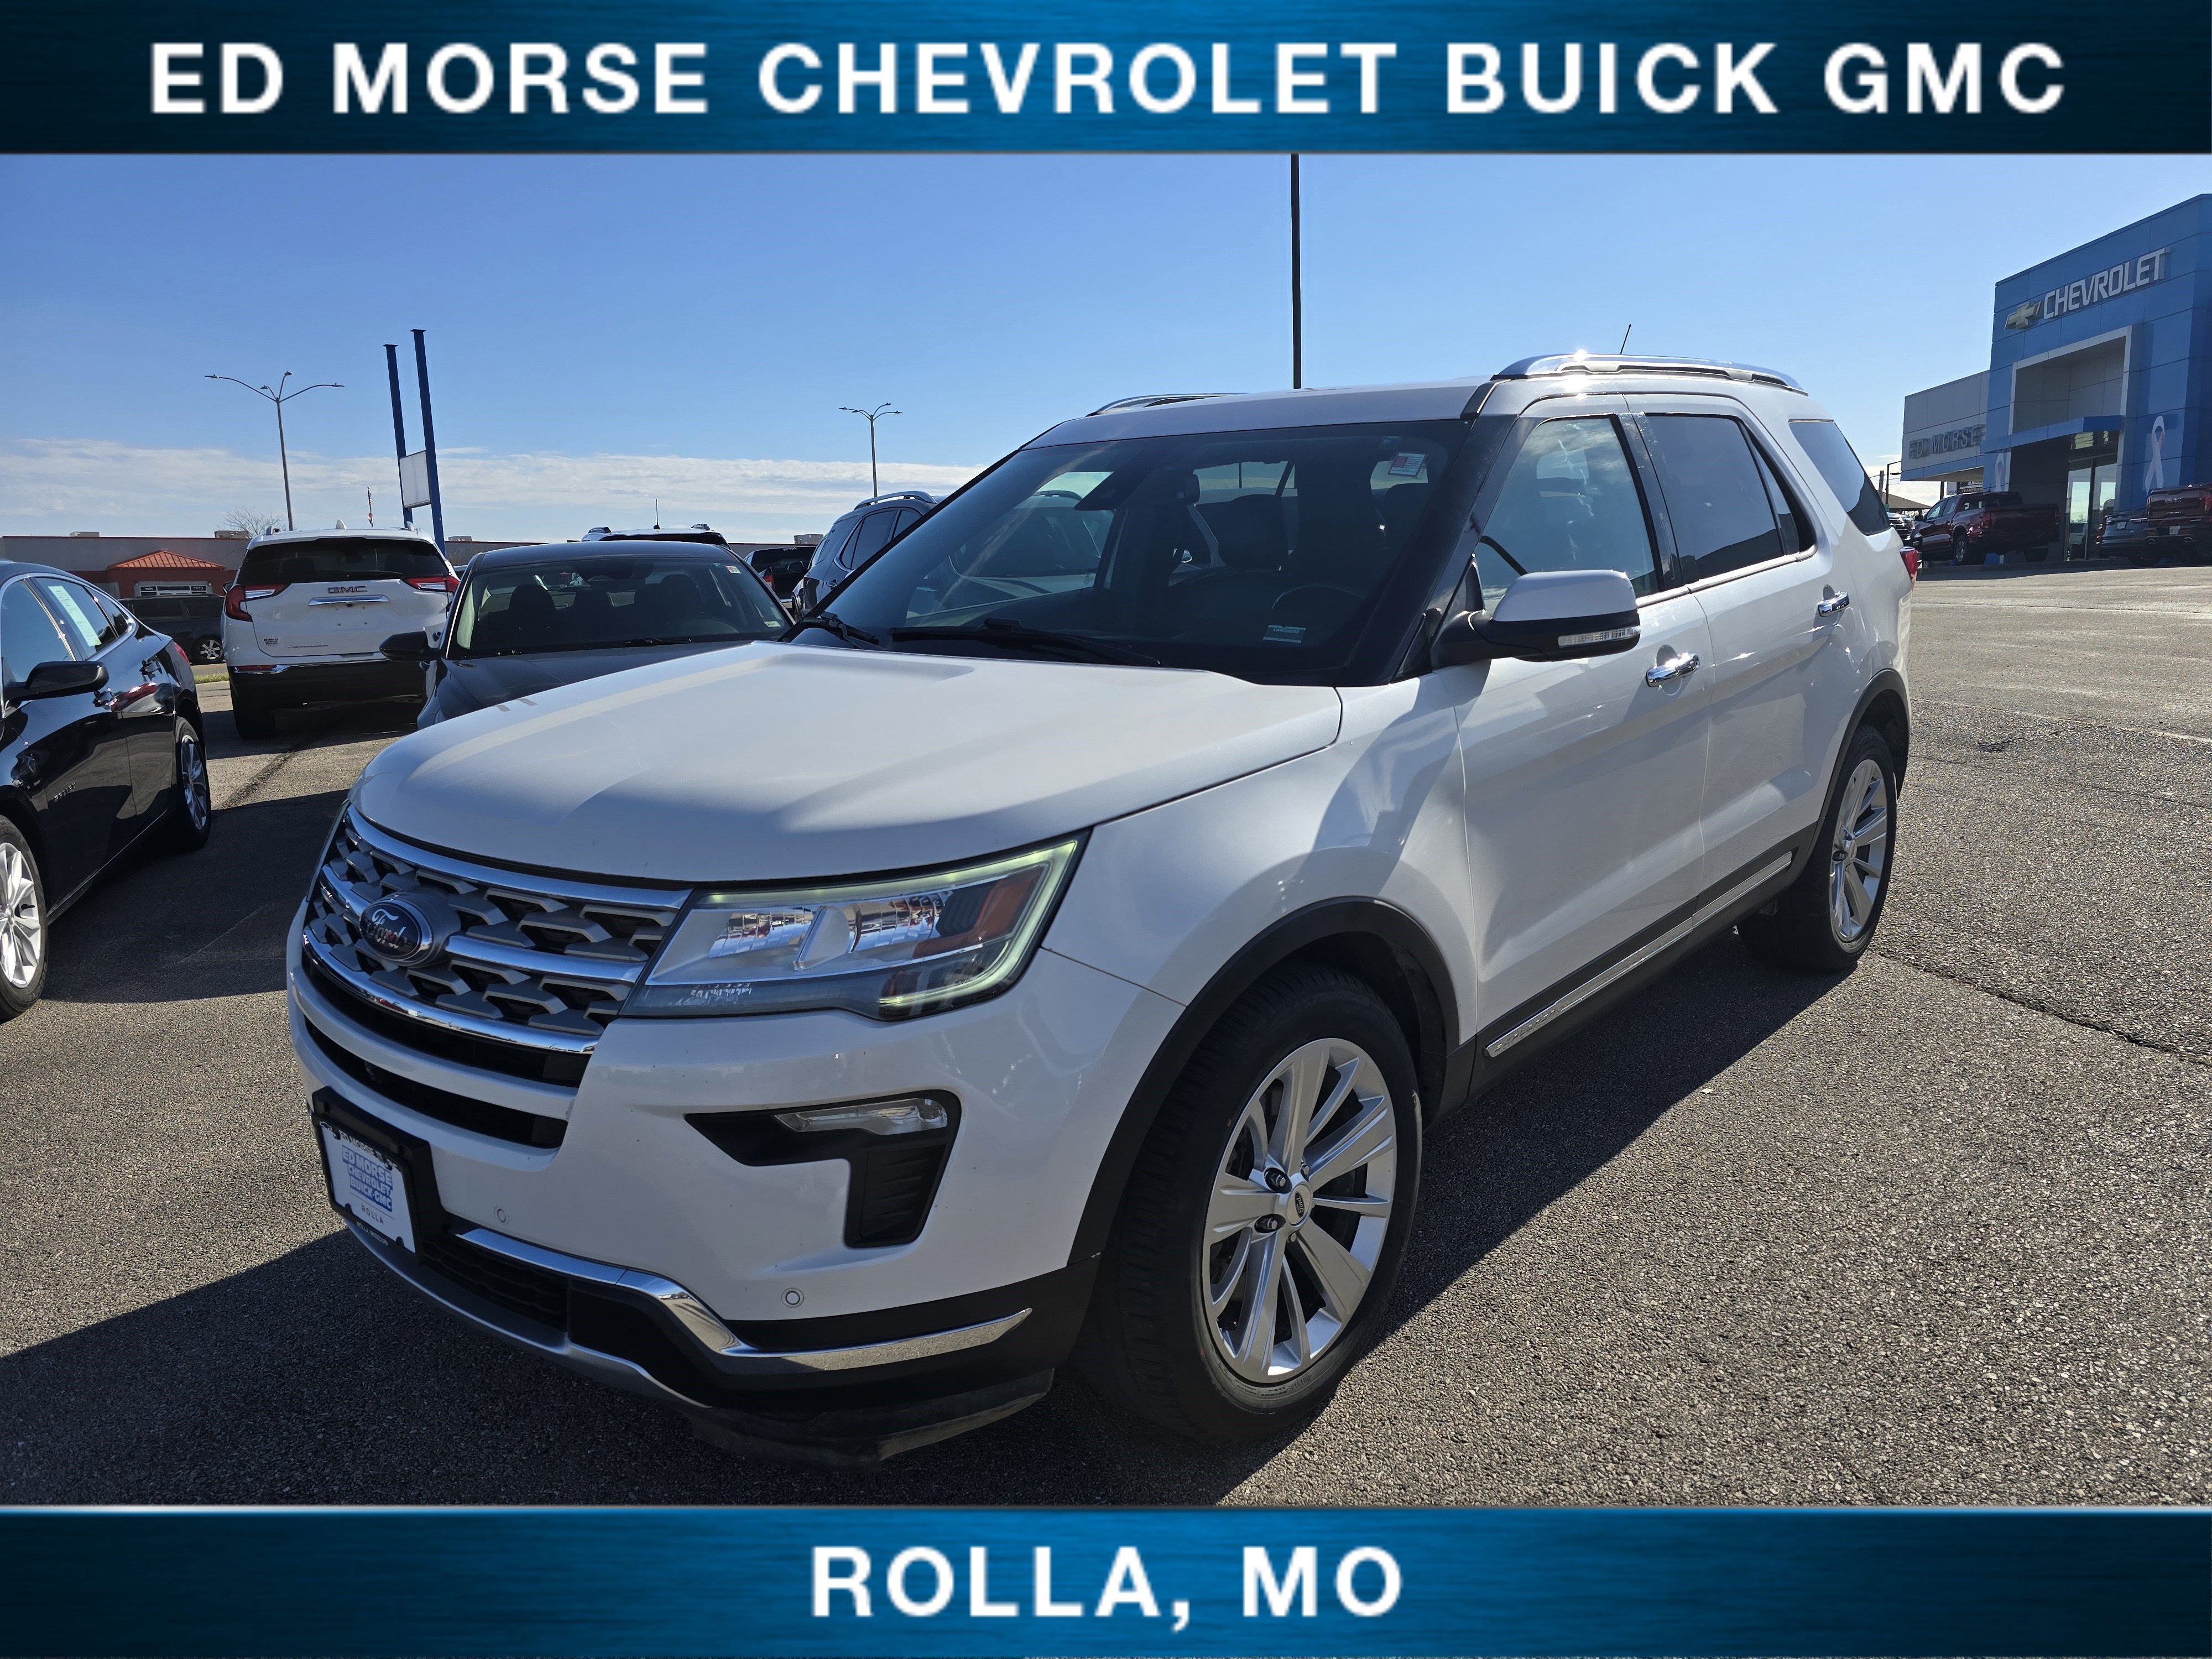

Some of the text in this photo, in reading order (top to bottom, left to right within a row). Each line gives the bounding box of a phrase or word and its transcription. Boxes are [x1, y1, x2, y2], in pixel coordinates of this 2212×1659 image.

[2043, 247, 2166, 320] CHEVROLET
[1909, 425, 1981, 458] ED MORSE
[342, 1149, 354, 1162] ED
[356, 1155, 392, 1187] MORSE
[348, 1165, 391, 1197] CHEVROLET
[361, 1204, 384, 1225] ROLLA
